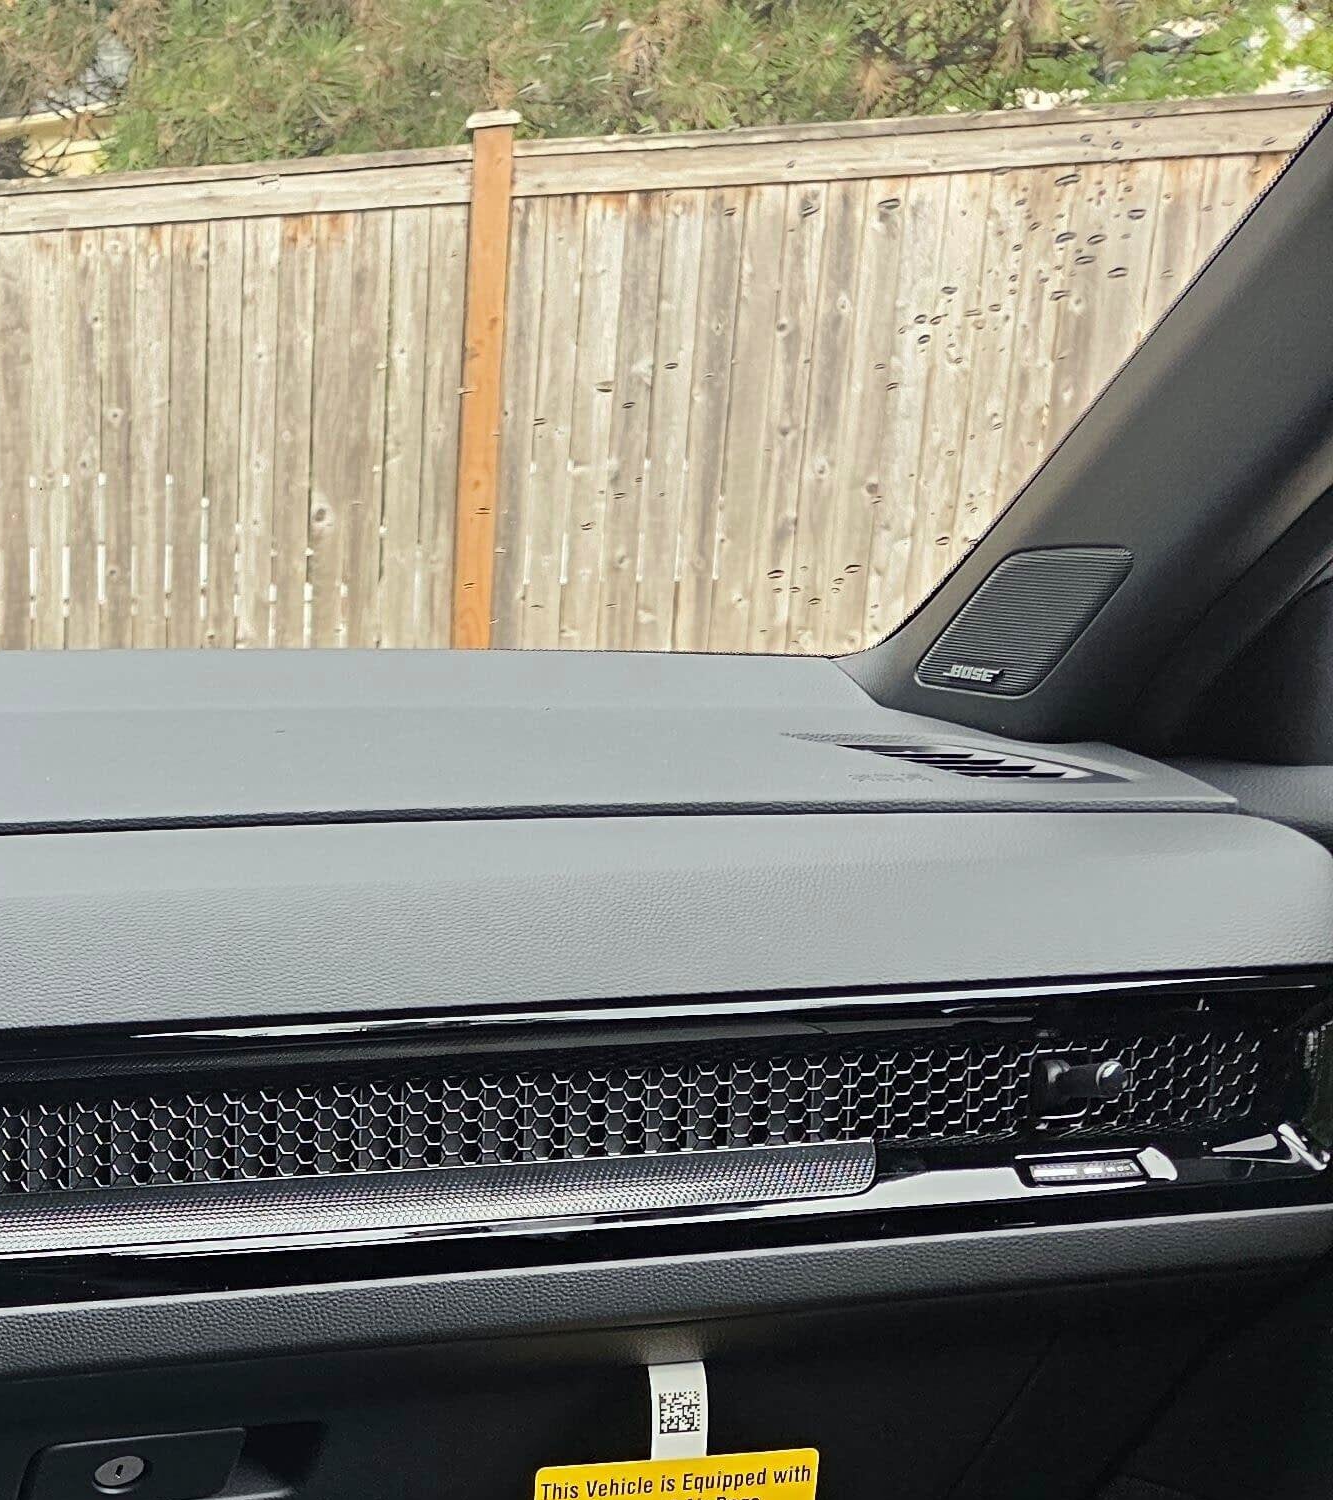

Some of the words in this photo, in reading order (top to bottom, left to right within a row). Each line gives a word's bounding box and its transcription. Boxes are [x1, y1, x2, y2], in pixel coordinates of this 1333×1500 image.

[943, 665, 1005, 683] BOSE
[541, 1481, 579, 1500] This
[586, 1476, 653, 1498] Vehicle
[661, 1474, 676, 1493] is
[682, 1467, 767, 1494] Equipped
[773, 1465, 811, 1484] with
